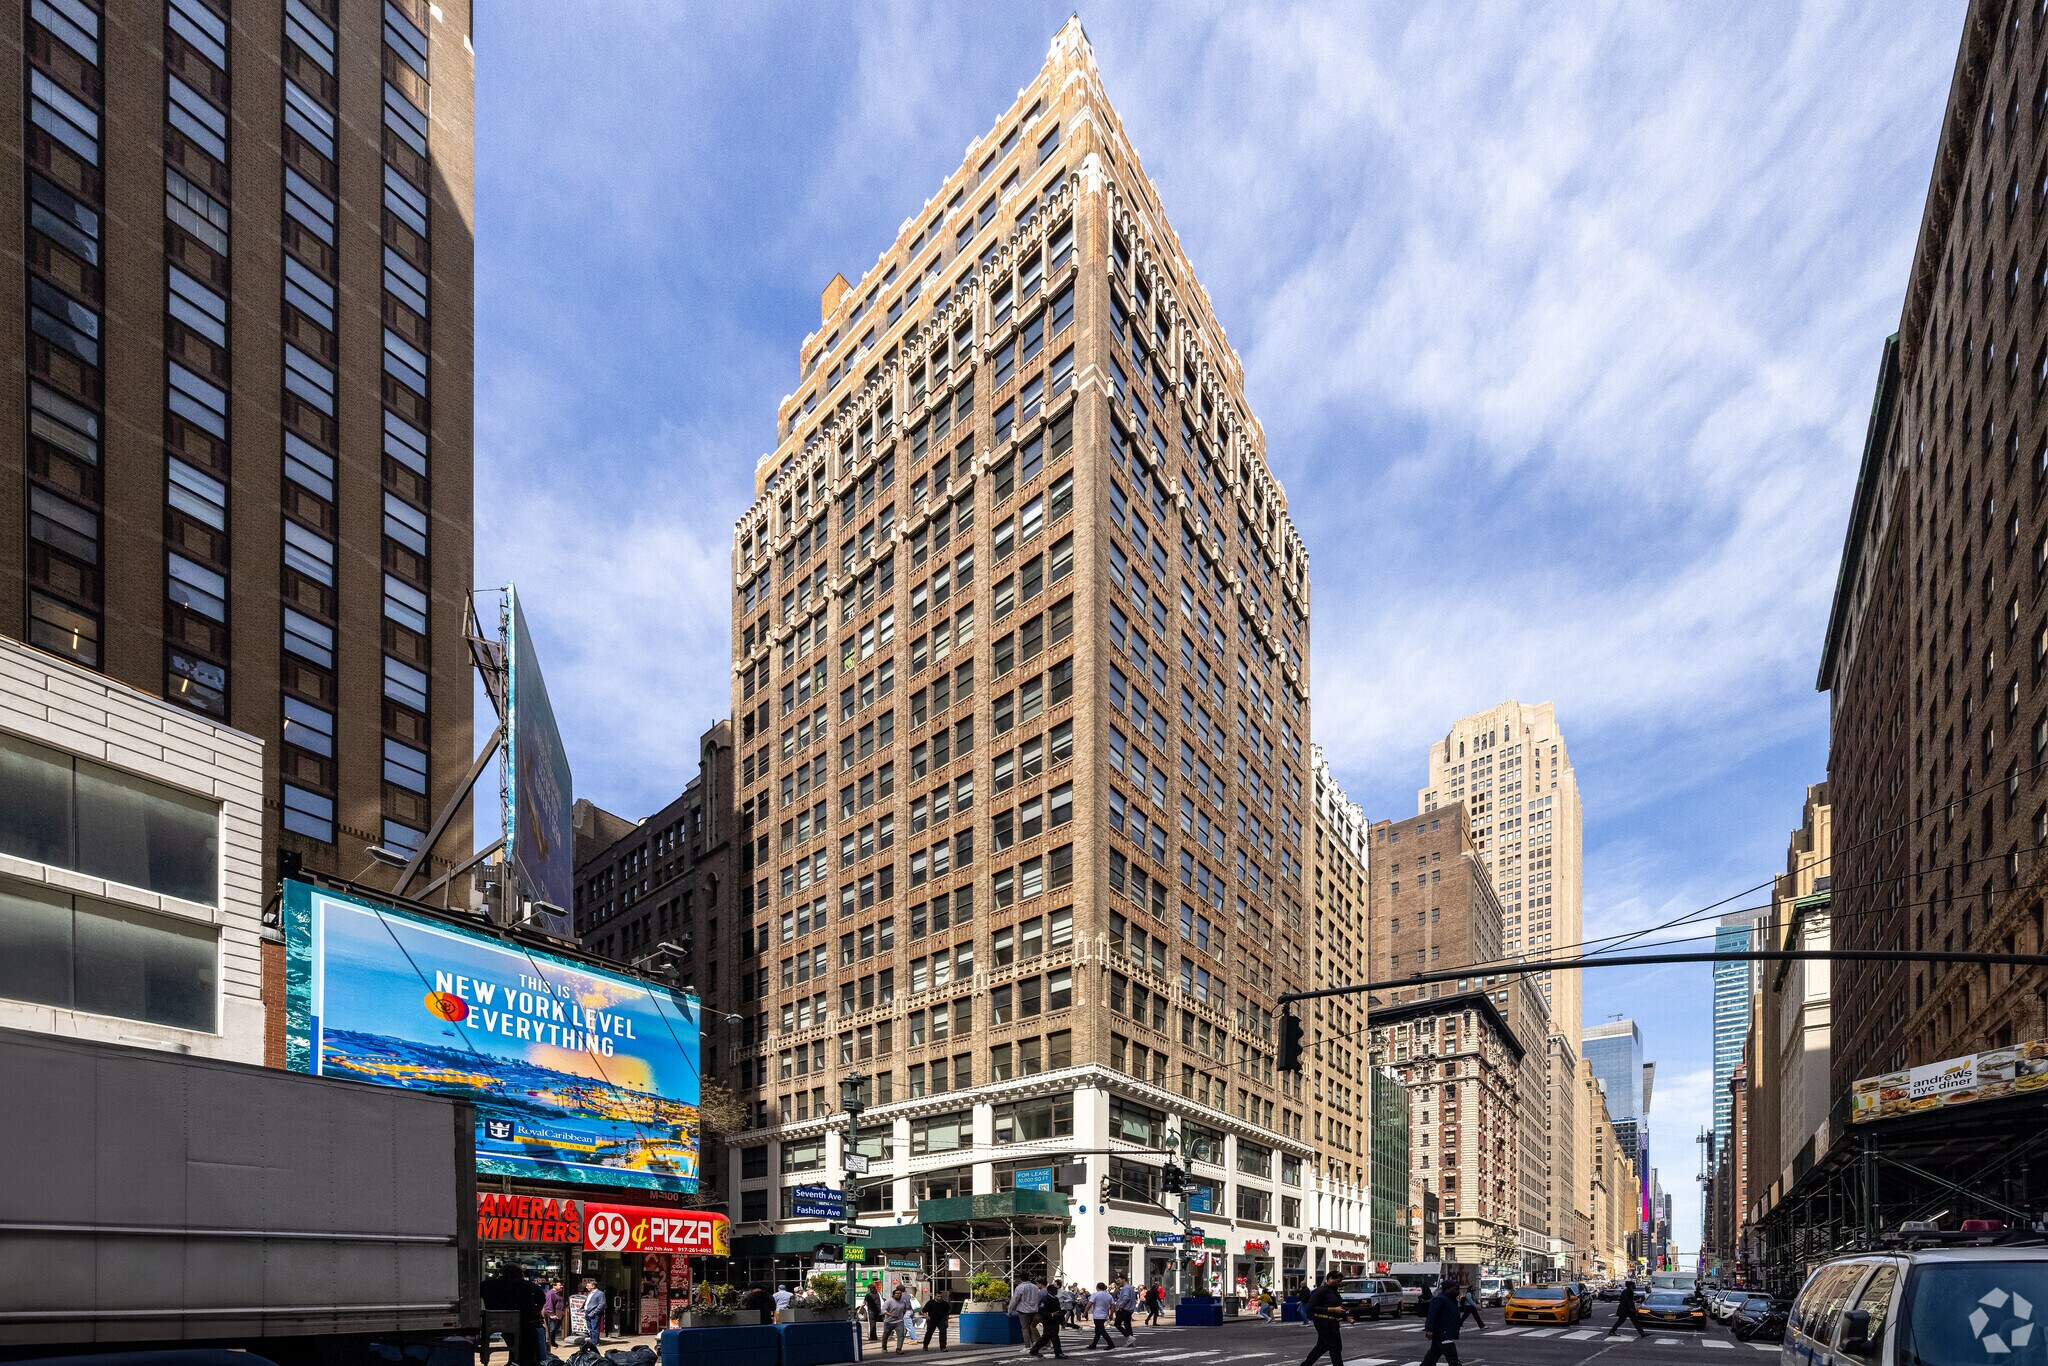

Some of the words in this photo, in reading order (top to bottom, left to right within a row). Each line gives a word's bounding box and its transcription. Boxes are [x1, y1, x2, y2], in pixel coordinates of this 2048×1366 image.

[519, 974, 550, 994] THIS
[558, 984, 570, 999] IS
[436, 970, 495, 1005] NEW
[504, 987, 565, 1023] YORK
[572, 1005, 636, 1040] LEVEL
[466, 1005, 614, 1058] EVERYTHING
[1913, 1085, 1935, 1095] nyc
[1938, 1078, 1973, 1090] diner
[795, 1189, 826, 1199] Seventh
[827, 1192, 842, 1201] Ave
[563, 1200, 579, 1222] &
[796, 1206, 825, 1216] Fashion
[826, 1209, 841, 1217] Ave
[651, 1217, 712, 1245] PIZZA
[1108, 1226, 1151, 1238] STARBUCKS
